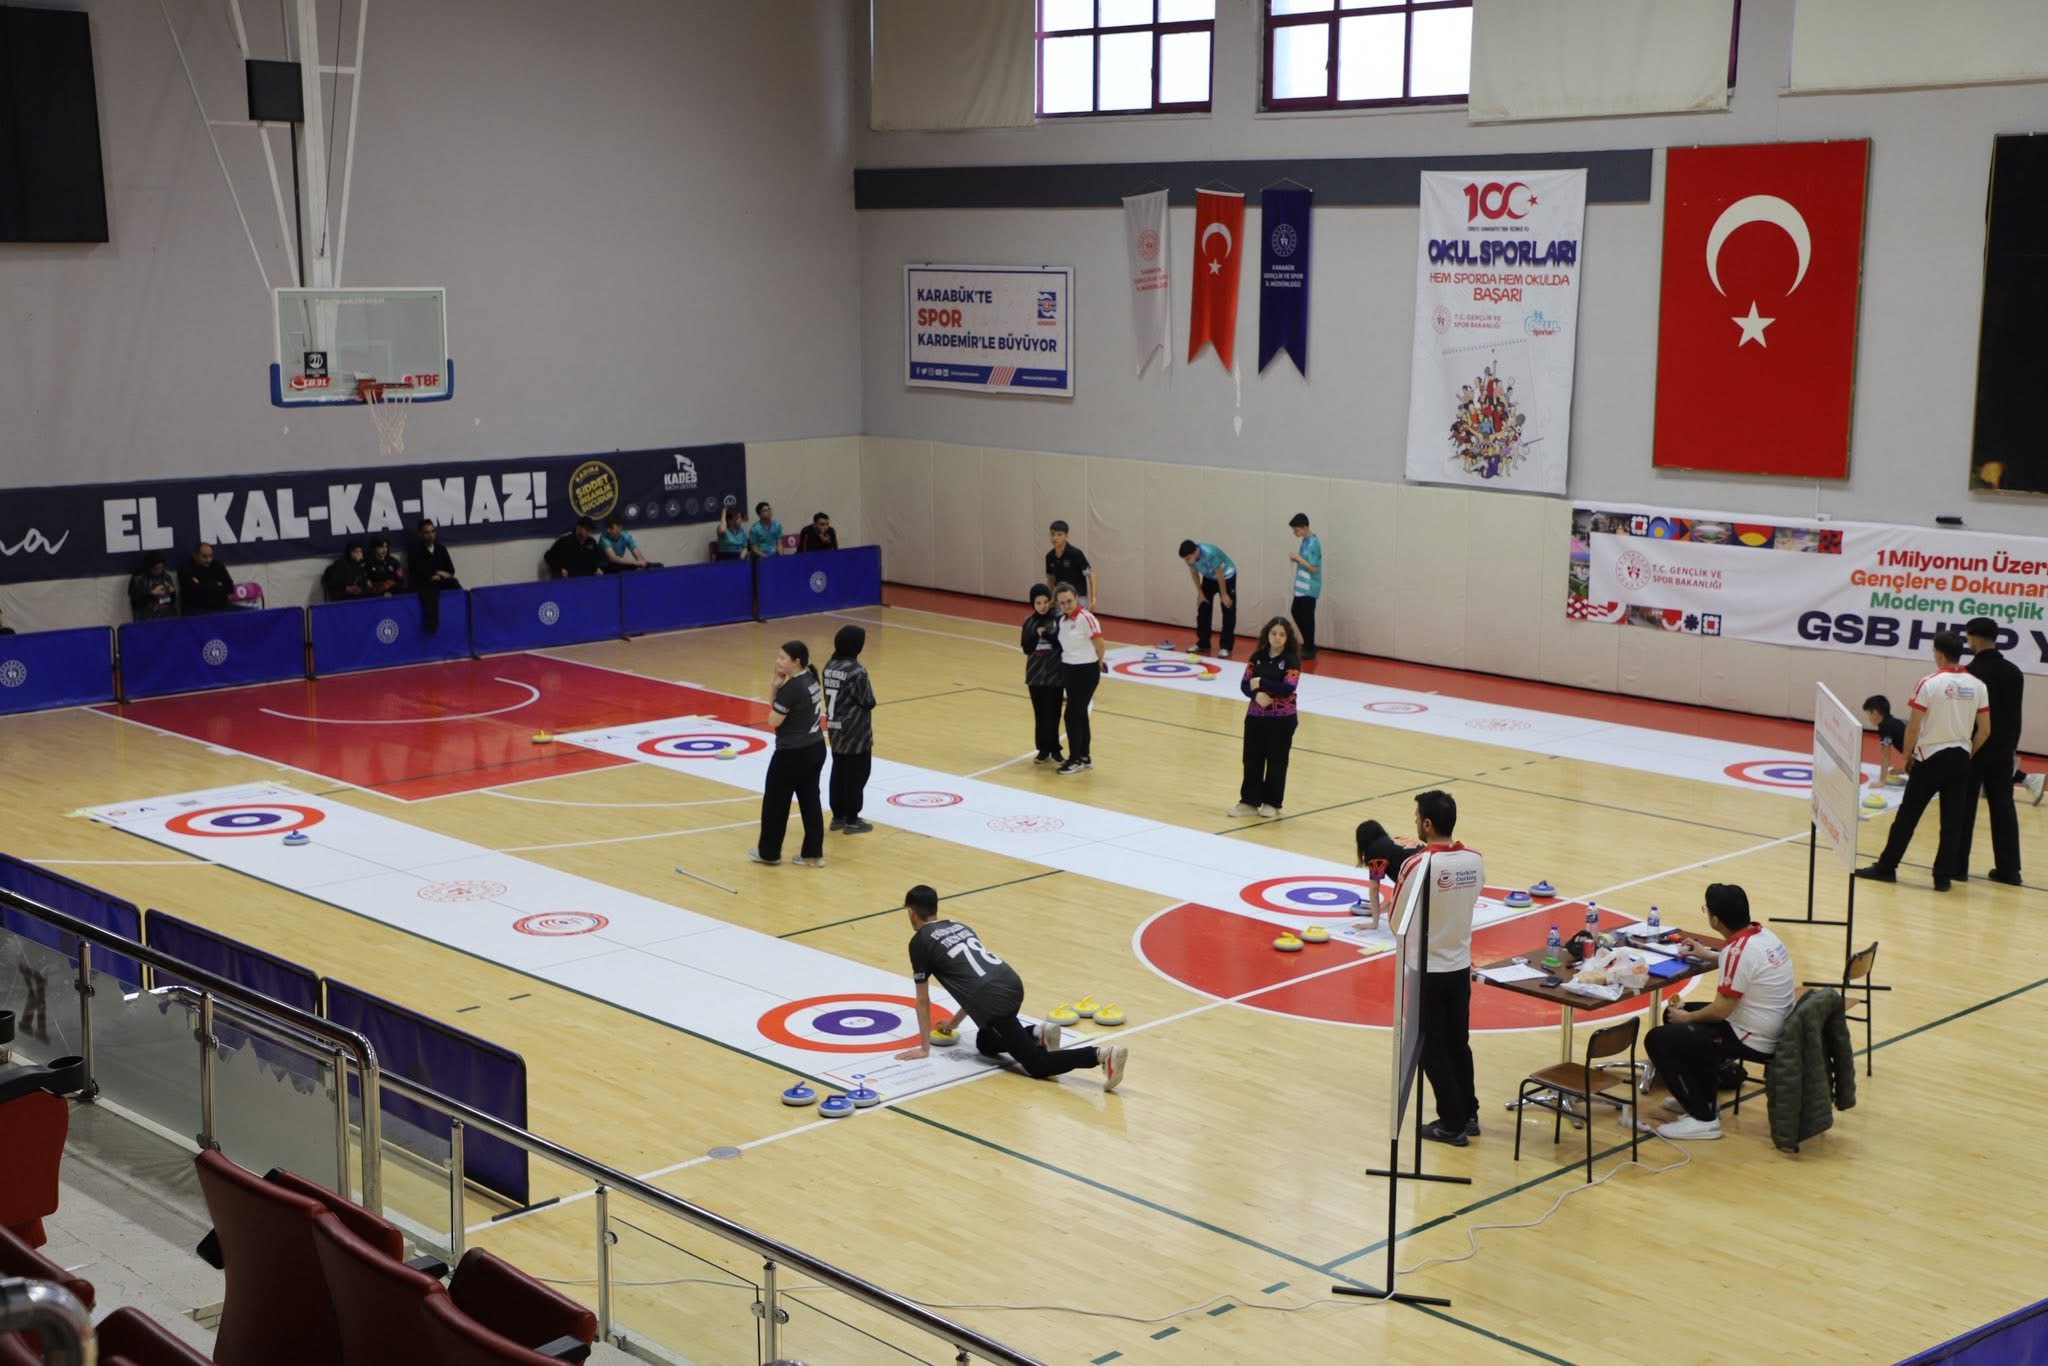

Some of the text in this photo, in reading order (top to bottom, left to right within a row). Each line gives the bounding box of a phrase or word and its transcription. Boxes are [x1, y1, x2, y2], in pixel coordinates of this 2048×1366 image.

[1428, 239, 1577, 266] OKUL SPORLARI
[1430, 272, 1570, 286] HEM SPORDA HEM OKULDA
[917, 286, 992, 304] KARABÜK'TE
[1473, 288, 1522, 303] BAŞARI
[917, 308, 962, 327] SPOR
[918, 332, 1057, 352] KARDEMİR'LE BÜYÜYOR
[416, 375, 439, 387] TBF
[664, 472, 698, 486] KADES
[103, 496, 174, 553] EL
[197, 471, 548, 545] KAL-KA-MAZ!
[1652, 564, 1667, 573] T.C.
[1711, 570, 1722, 579] VE
[1877, 550, 2048, 575] 1 Milyonun Üzer
[1652, 575, 1722, 589] SPOR BAKANLIĞI
[1850, 569, 1947, 593] Gençlere
[1870, 592, 2044, 623] Modern Gençlik
[1797, 610, 1901, 648] GSB
